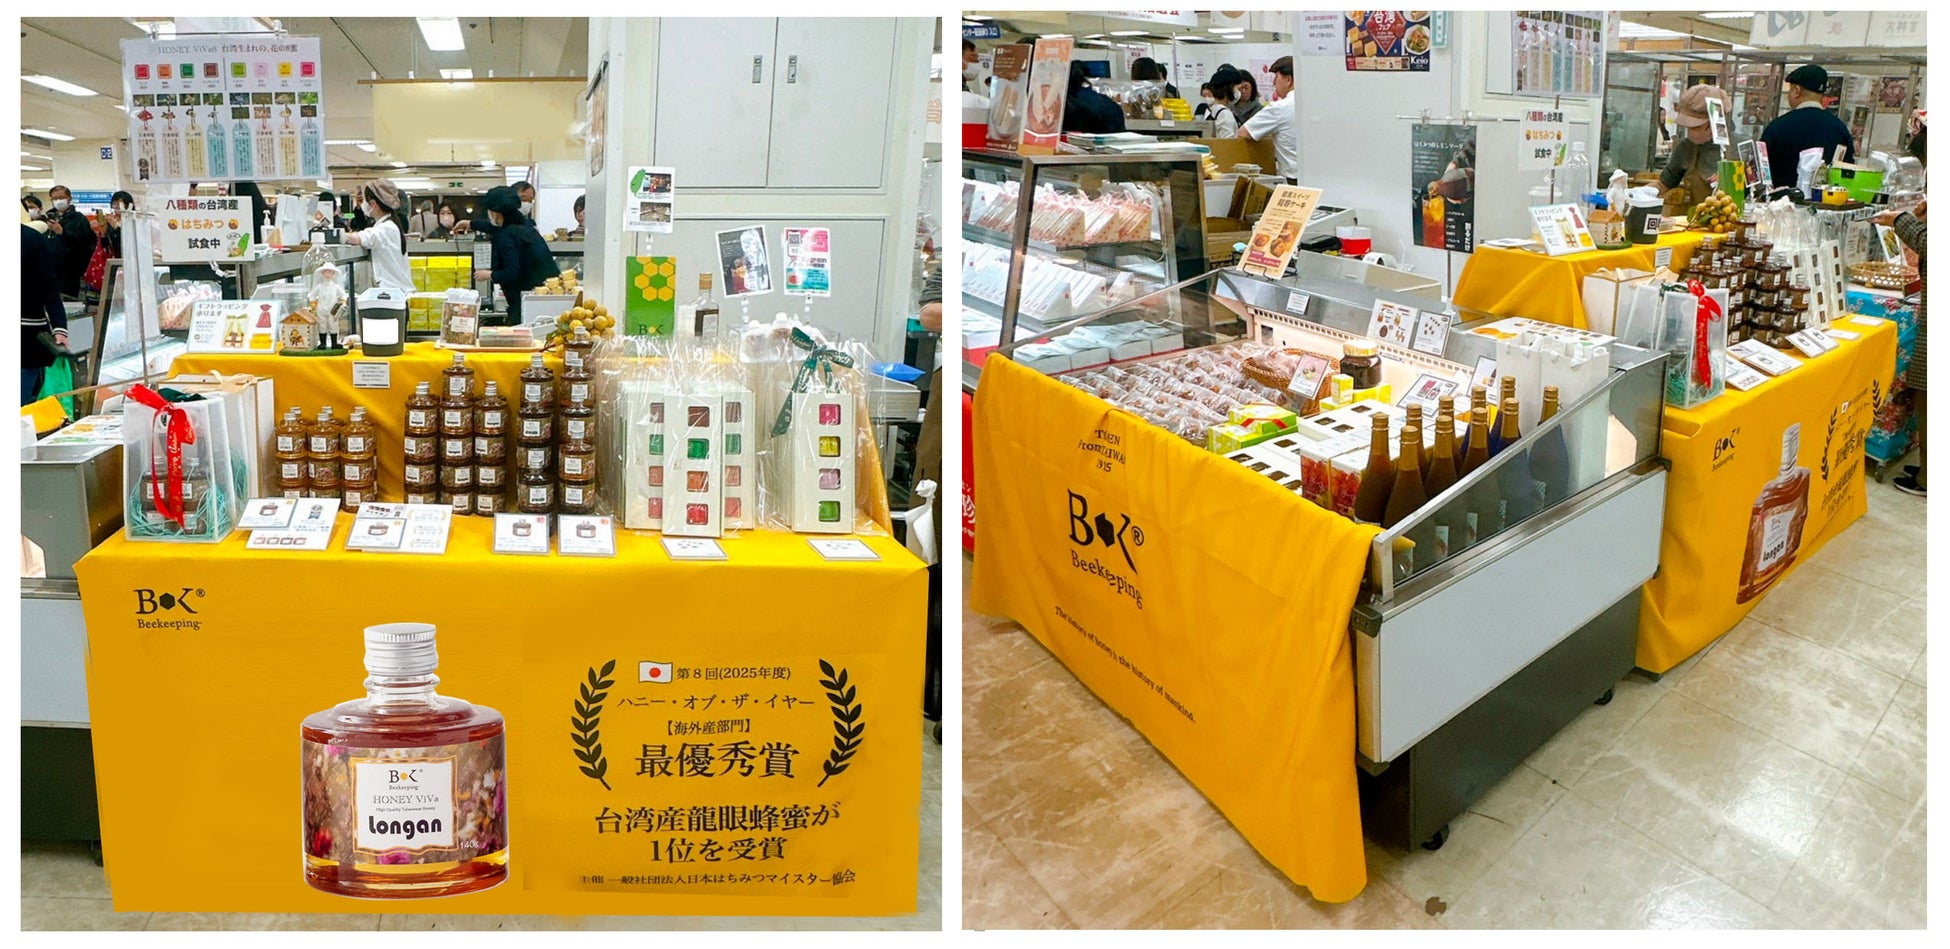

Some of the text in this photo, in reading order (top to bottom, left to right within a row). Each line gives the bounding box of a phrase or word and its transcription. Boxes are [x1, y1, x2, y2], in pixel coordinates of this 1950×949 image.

[1410, 56, 1428, 65] Keio
[166, 198, 239, 211] 八種類の台湾産
[181, 218, 224, 230] はちみつ
[188, 238, 221, 249] 試食中
[136, 618, 203, 631] Beekeeping
[1055, 605, 1067, 620] The
[1118, 655, 1131, 670] the
[1131, 663, 1155, 689] history
[1155, 685, 1164, 695] of
[617, 693, 816, 711] ハニー・オブ・ザ・イヤー
[667, 718, 751, 736] 【海外産部門】
[635, 740, 800, 779] 最優秀賞
[373, 794, 440, 804] HONEY ViVa
[594, 800, 842, 834] 台湾産龍眼蜂蜜が
[368, 815, 442, 840] Longan
[651, 836, 788, 864] 1位を受賞
